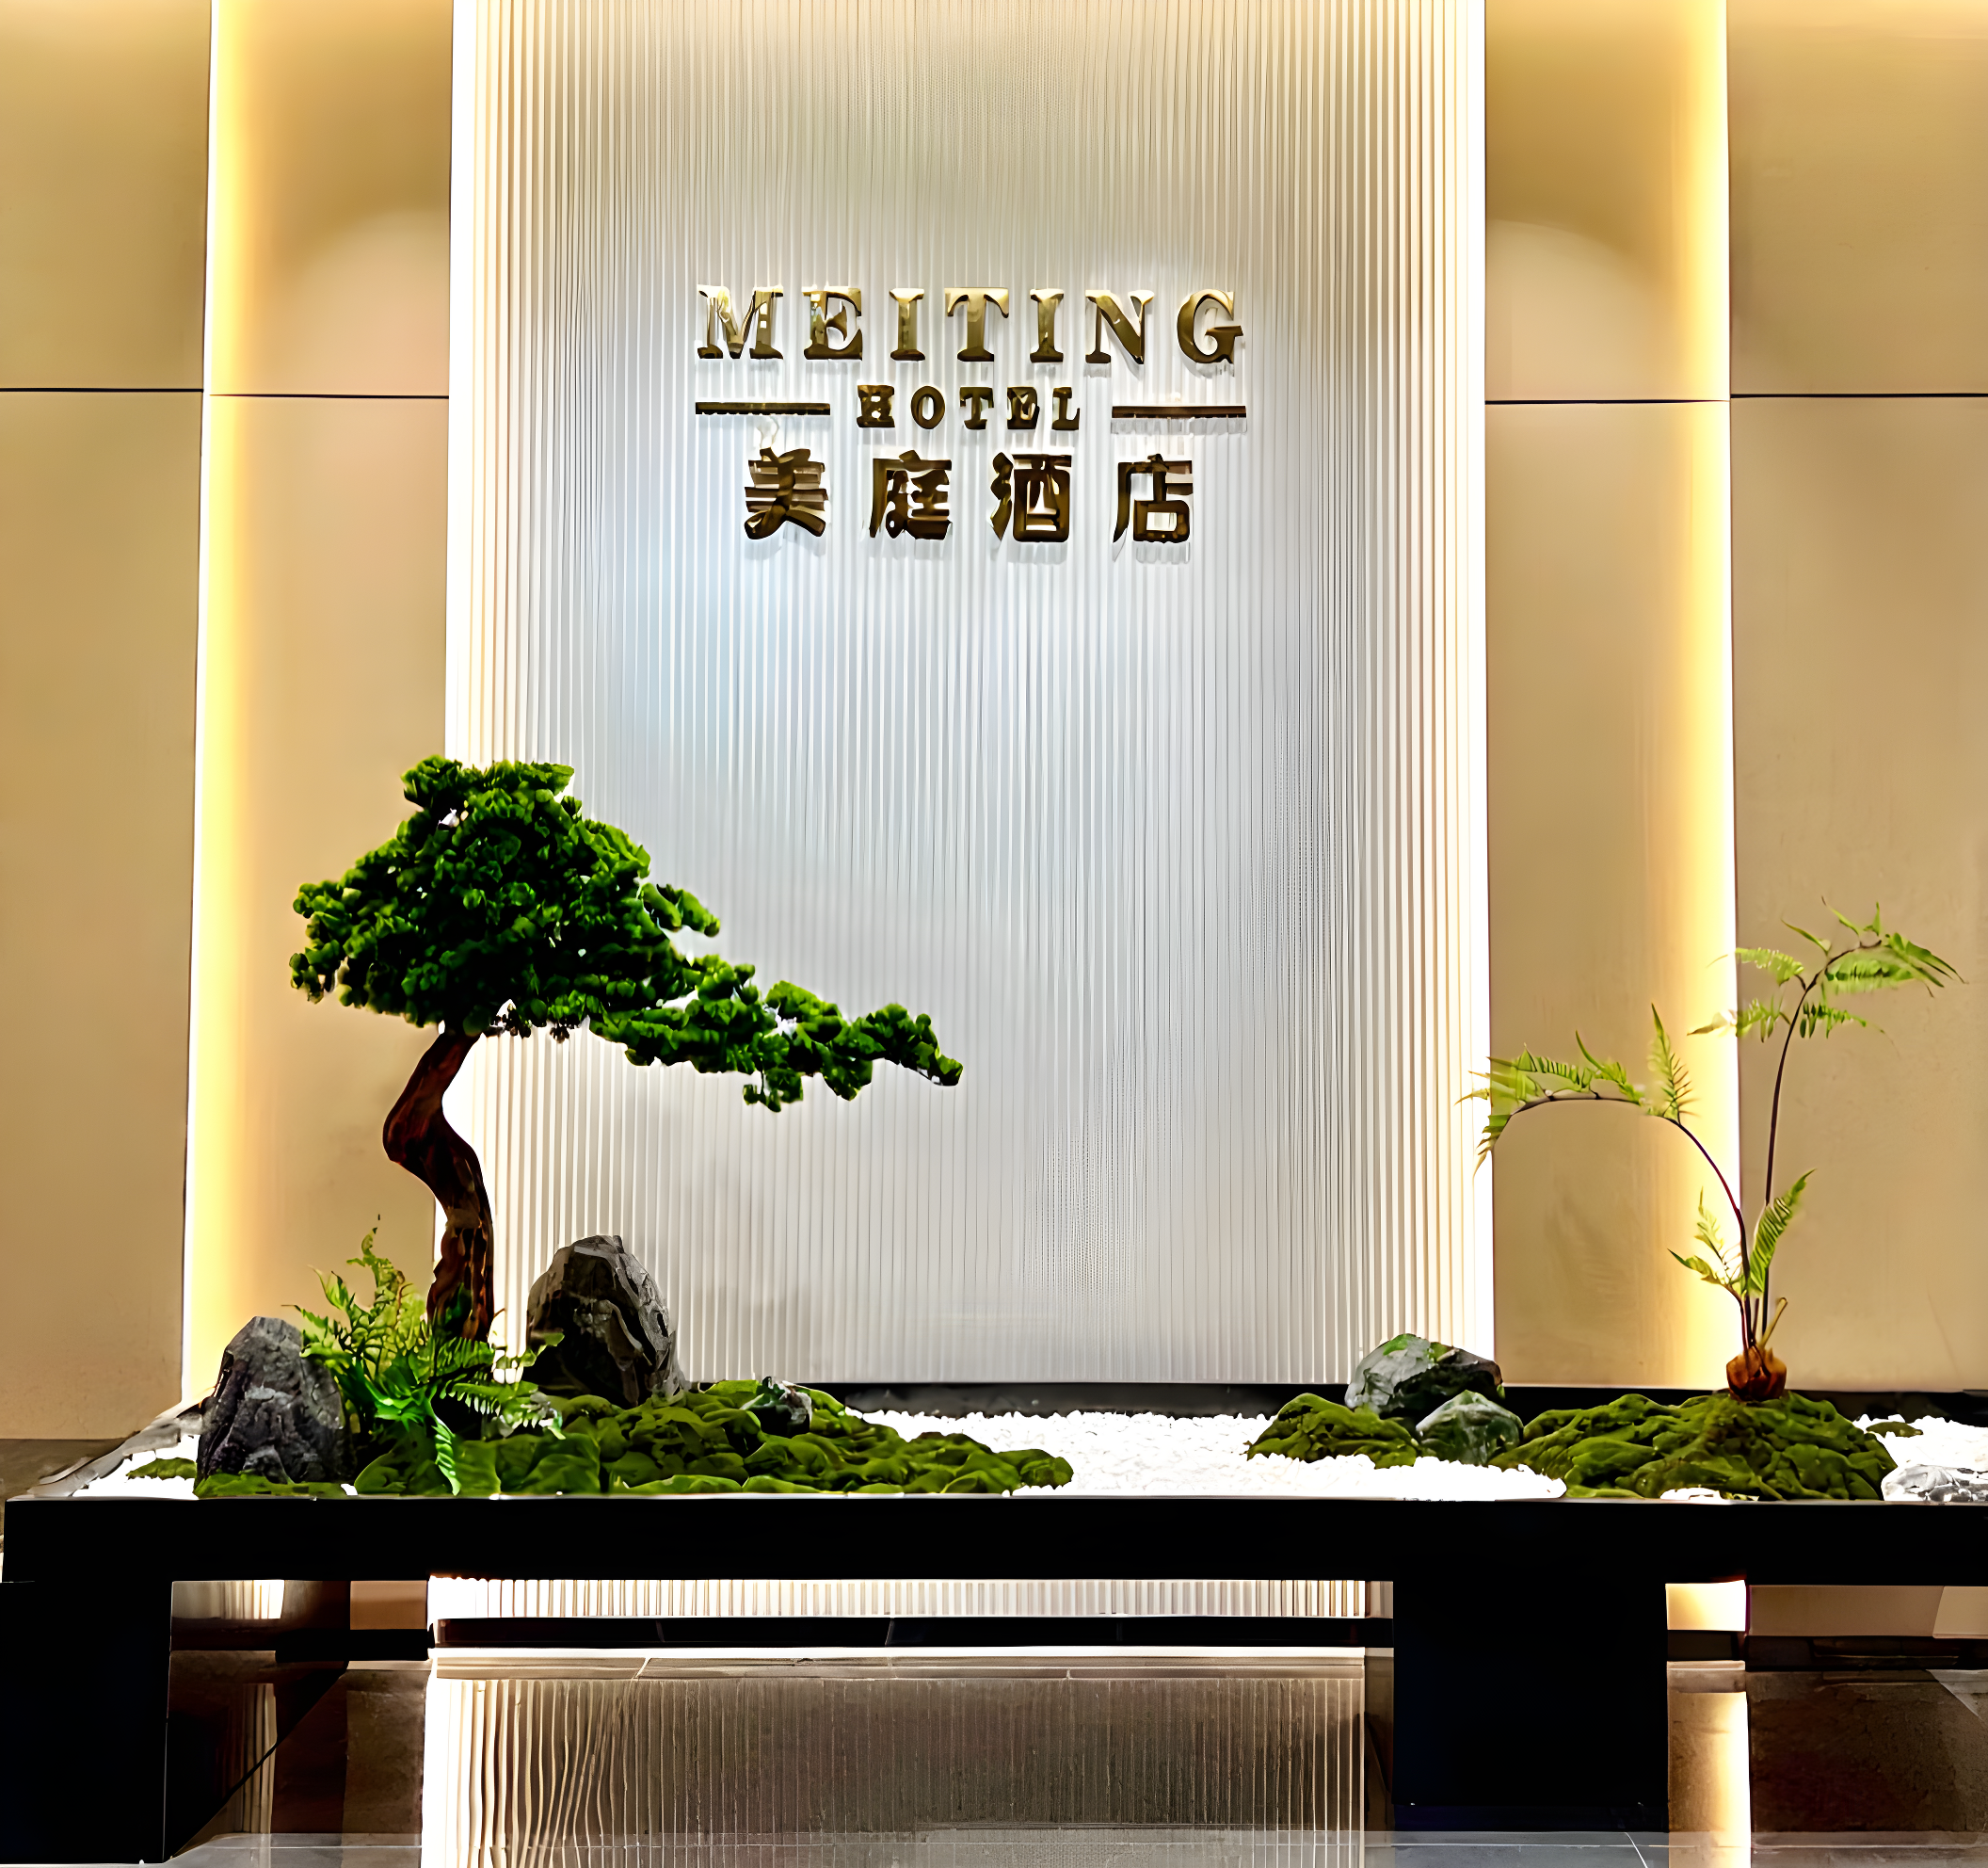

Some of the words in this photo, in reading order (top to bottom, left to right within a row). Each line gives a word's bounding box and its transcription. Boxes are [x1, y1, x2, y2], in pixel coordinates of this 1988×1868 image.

[697, 284, 1243, 363] MEITING
[856, 384, 1080, 430] HOTEL
[744, 448, 1194, 543] 美庭酒店
